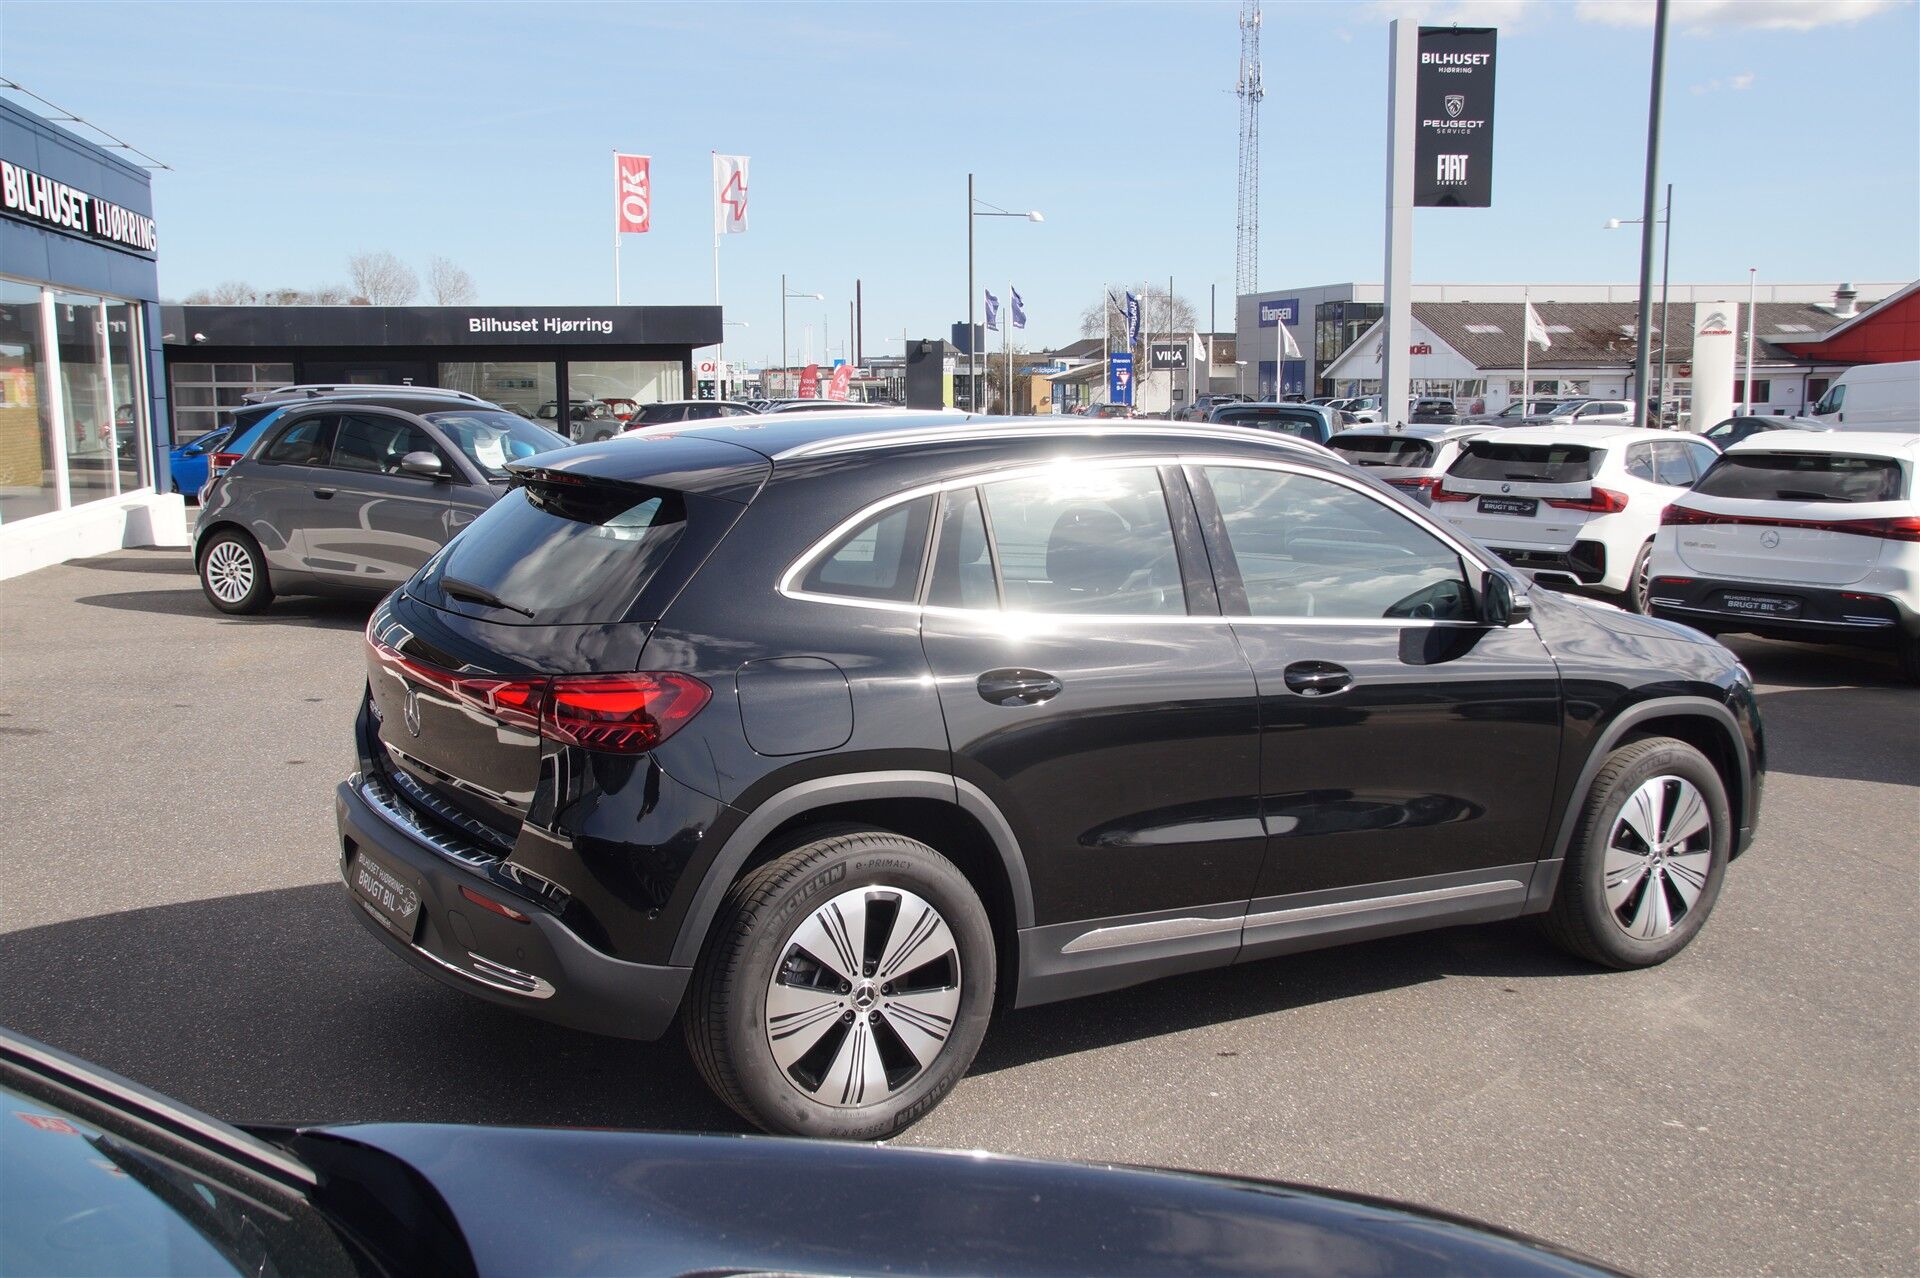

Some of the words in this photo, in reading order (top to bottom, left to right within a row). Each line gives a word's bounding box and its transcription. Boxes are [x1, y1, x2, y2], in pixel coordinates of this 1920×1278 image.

[1421, 53, 1490, 65] BILHUSET
[1423, 120, 1485, 128] PEUGEOT
[1437, 154, 1469, 180] FIAT
[621, 166, 648, 224] OK
[1, 159, 89, 232] BILHUSET
[94, 198, 157, 251] HJØRRING
[1261, 305, 1292, 321] thansen
[468, 318, 538, 332] Bilhuset
[544, 318, 613, 334] Hjørring
[1727, 600, 1760, 609] BRUGT
[1760, 603, 1776, 611] BIL
[358, 853, 380, 876] BILHUSET
[358, 869, 384, 900] BRUGT
[383, 889, 395, 912] BIL
